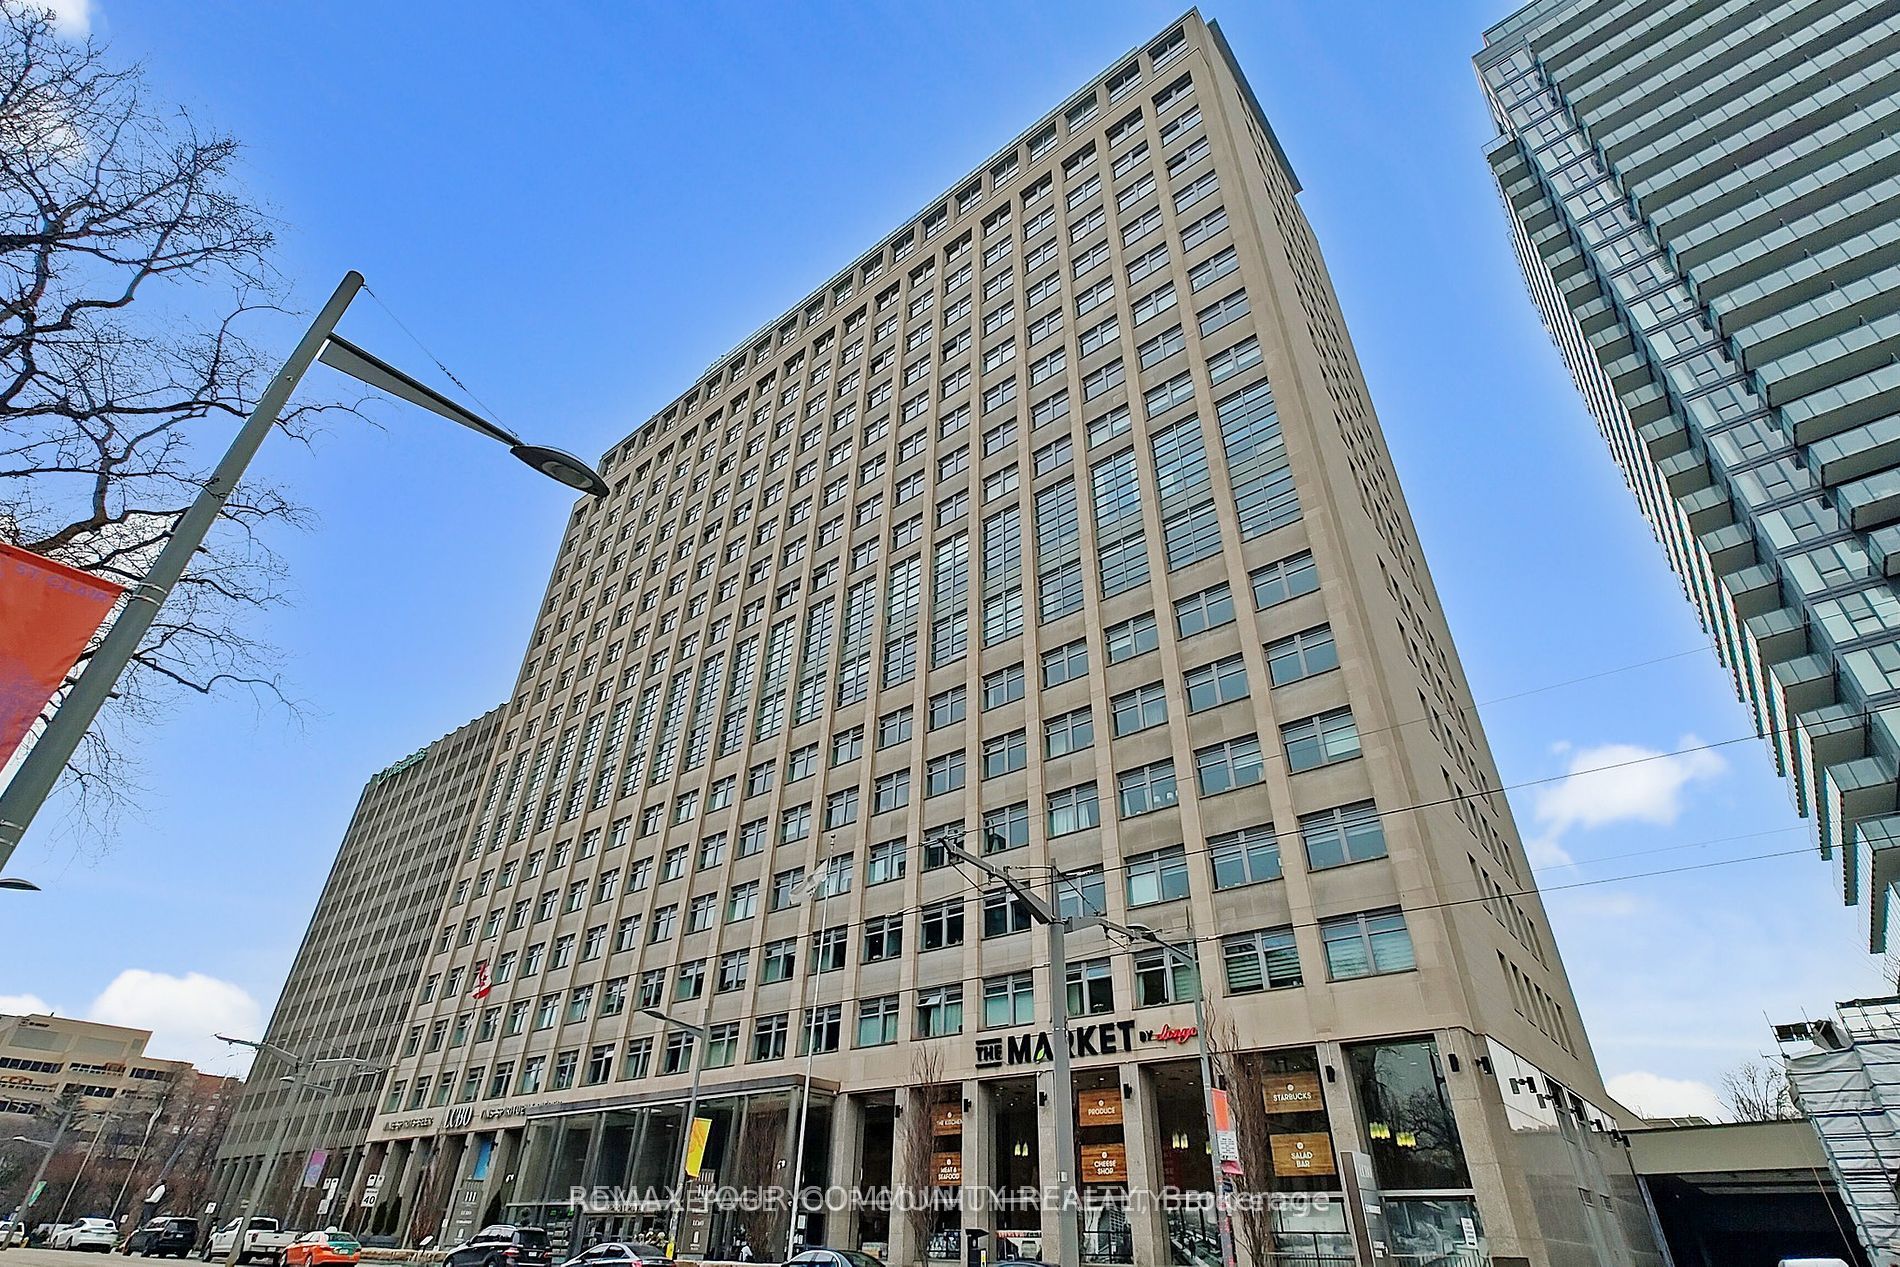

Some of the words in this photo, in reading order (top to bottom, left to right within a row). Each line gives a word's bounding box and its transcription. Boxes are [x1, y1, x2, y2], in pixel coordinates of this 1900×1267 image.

[976, 1044, 1003, 1062] THE
[1139, 1030, 1154, 1043] BY
[1273, 1092, 1312, 1102] STARBUCKS
[1088, 1107, 1116, 1115] PRODUCE
[444, 1106, 473, 1129] LCBO
[1290, 1151, 1313, 1160] SALAD
[1094, 1160, 1117, 1168] CHEESE
[1296, 1159, 1311, 1168] BAR
[1097, 1167, 1114, 1175] SHOP
[363, 1196, 376, 1205] 40
